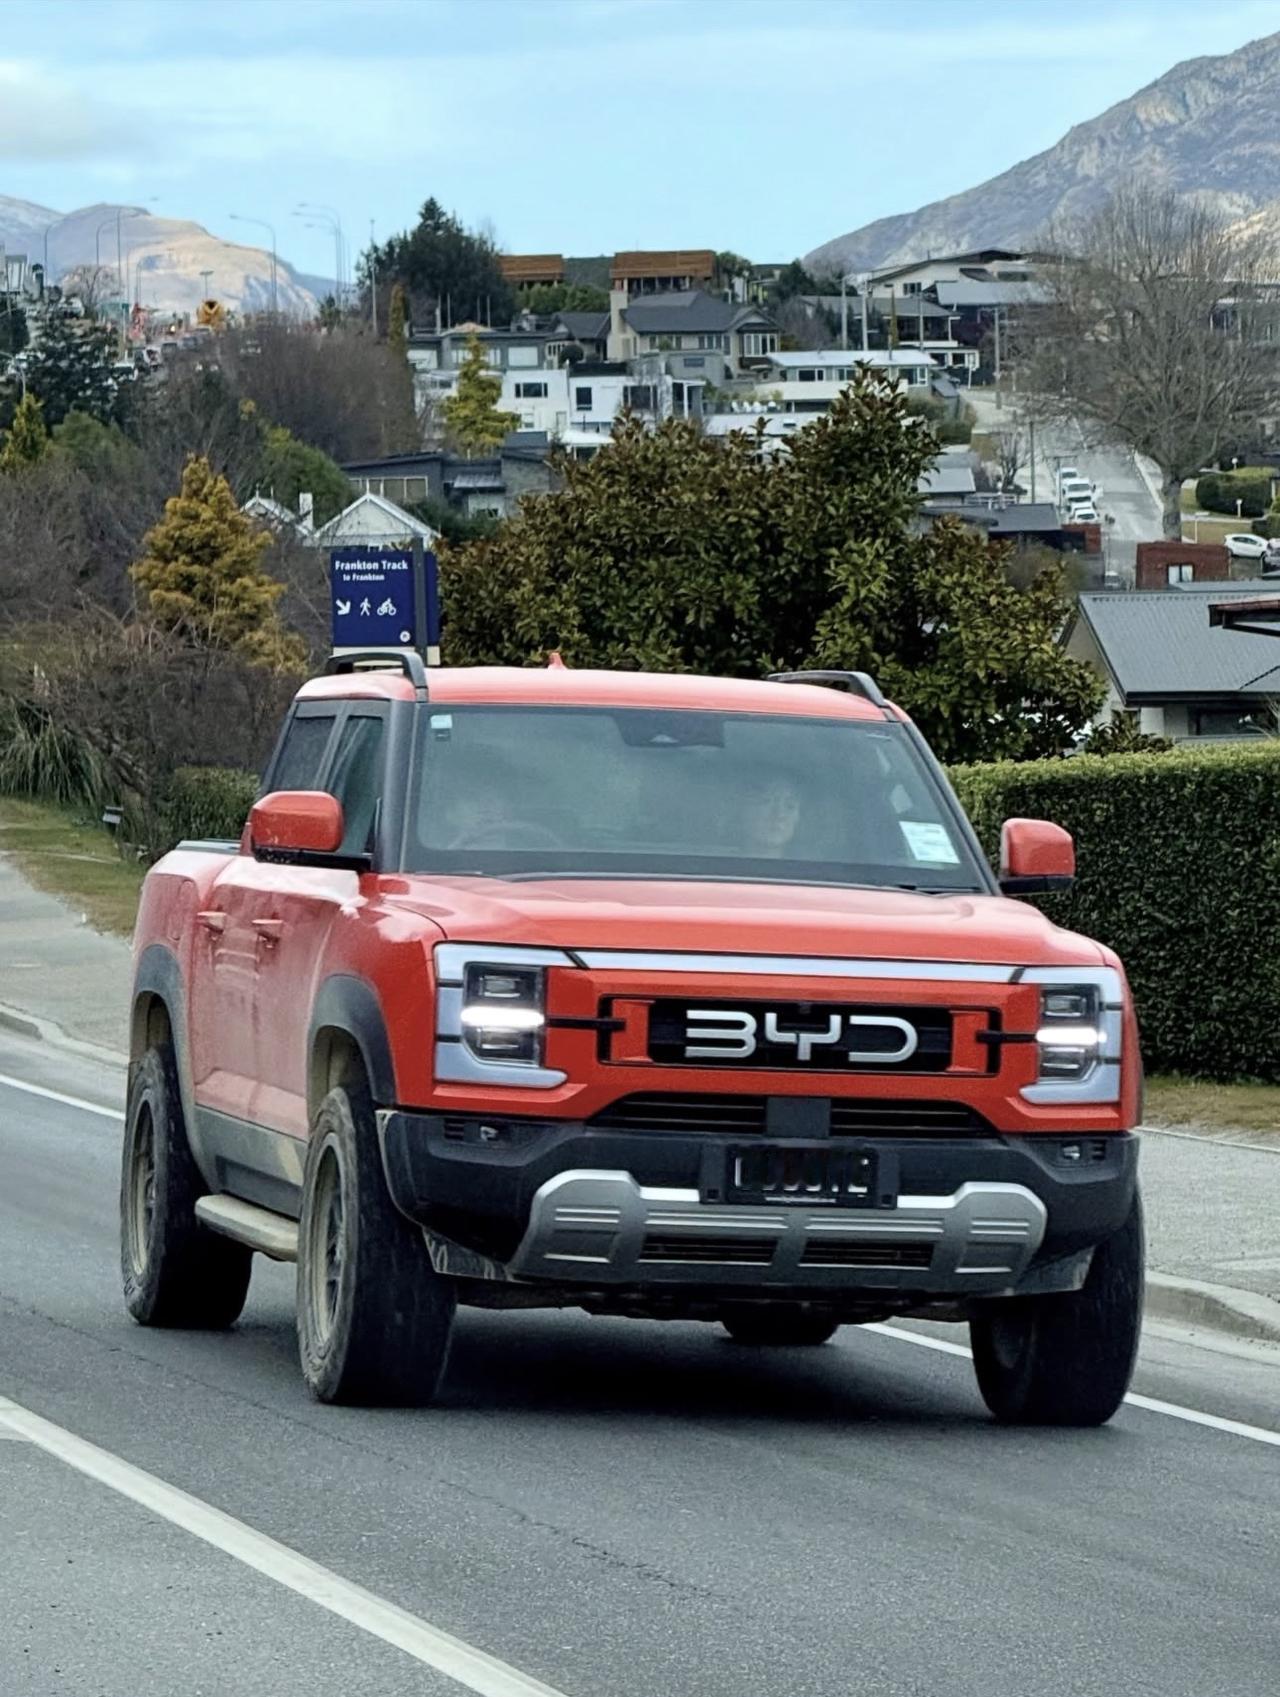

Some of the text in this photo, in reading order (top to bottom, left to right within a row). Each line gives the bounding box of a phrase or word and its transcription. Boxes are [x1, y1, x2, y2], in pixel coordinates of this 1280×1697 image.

[335, 560, 408, 570] Frankton Track
[343, 573, 385, 581] to Frankton
[684, 1009, 918, 1063] BYD
